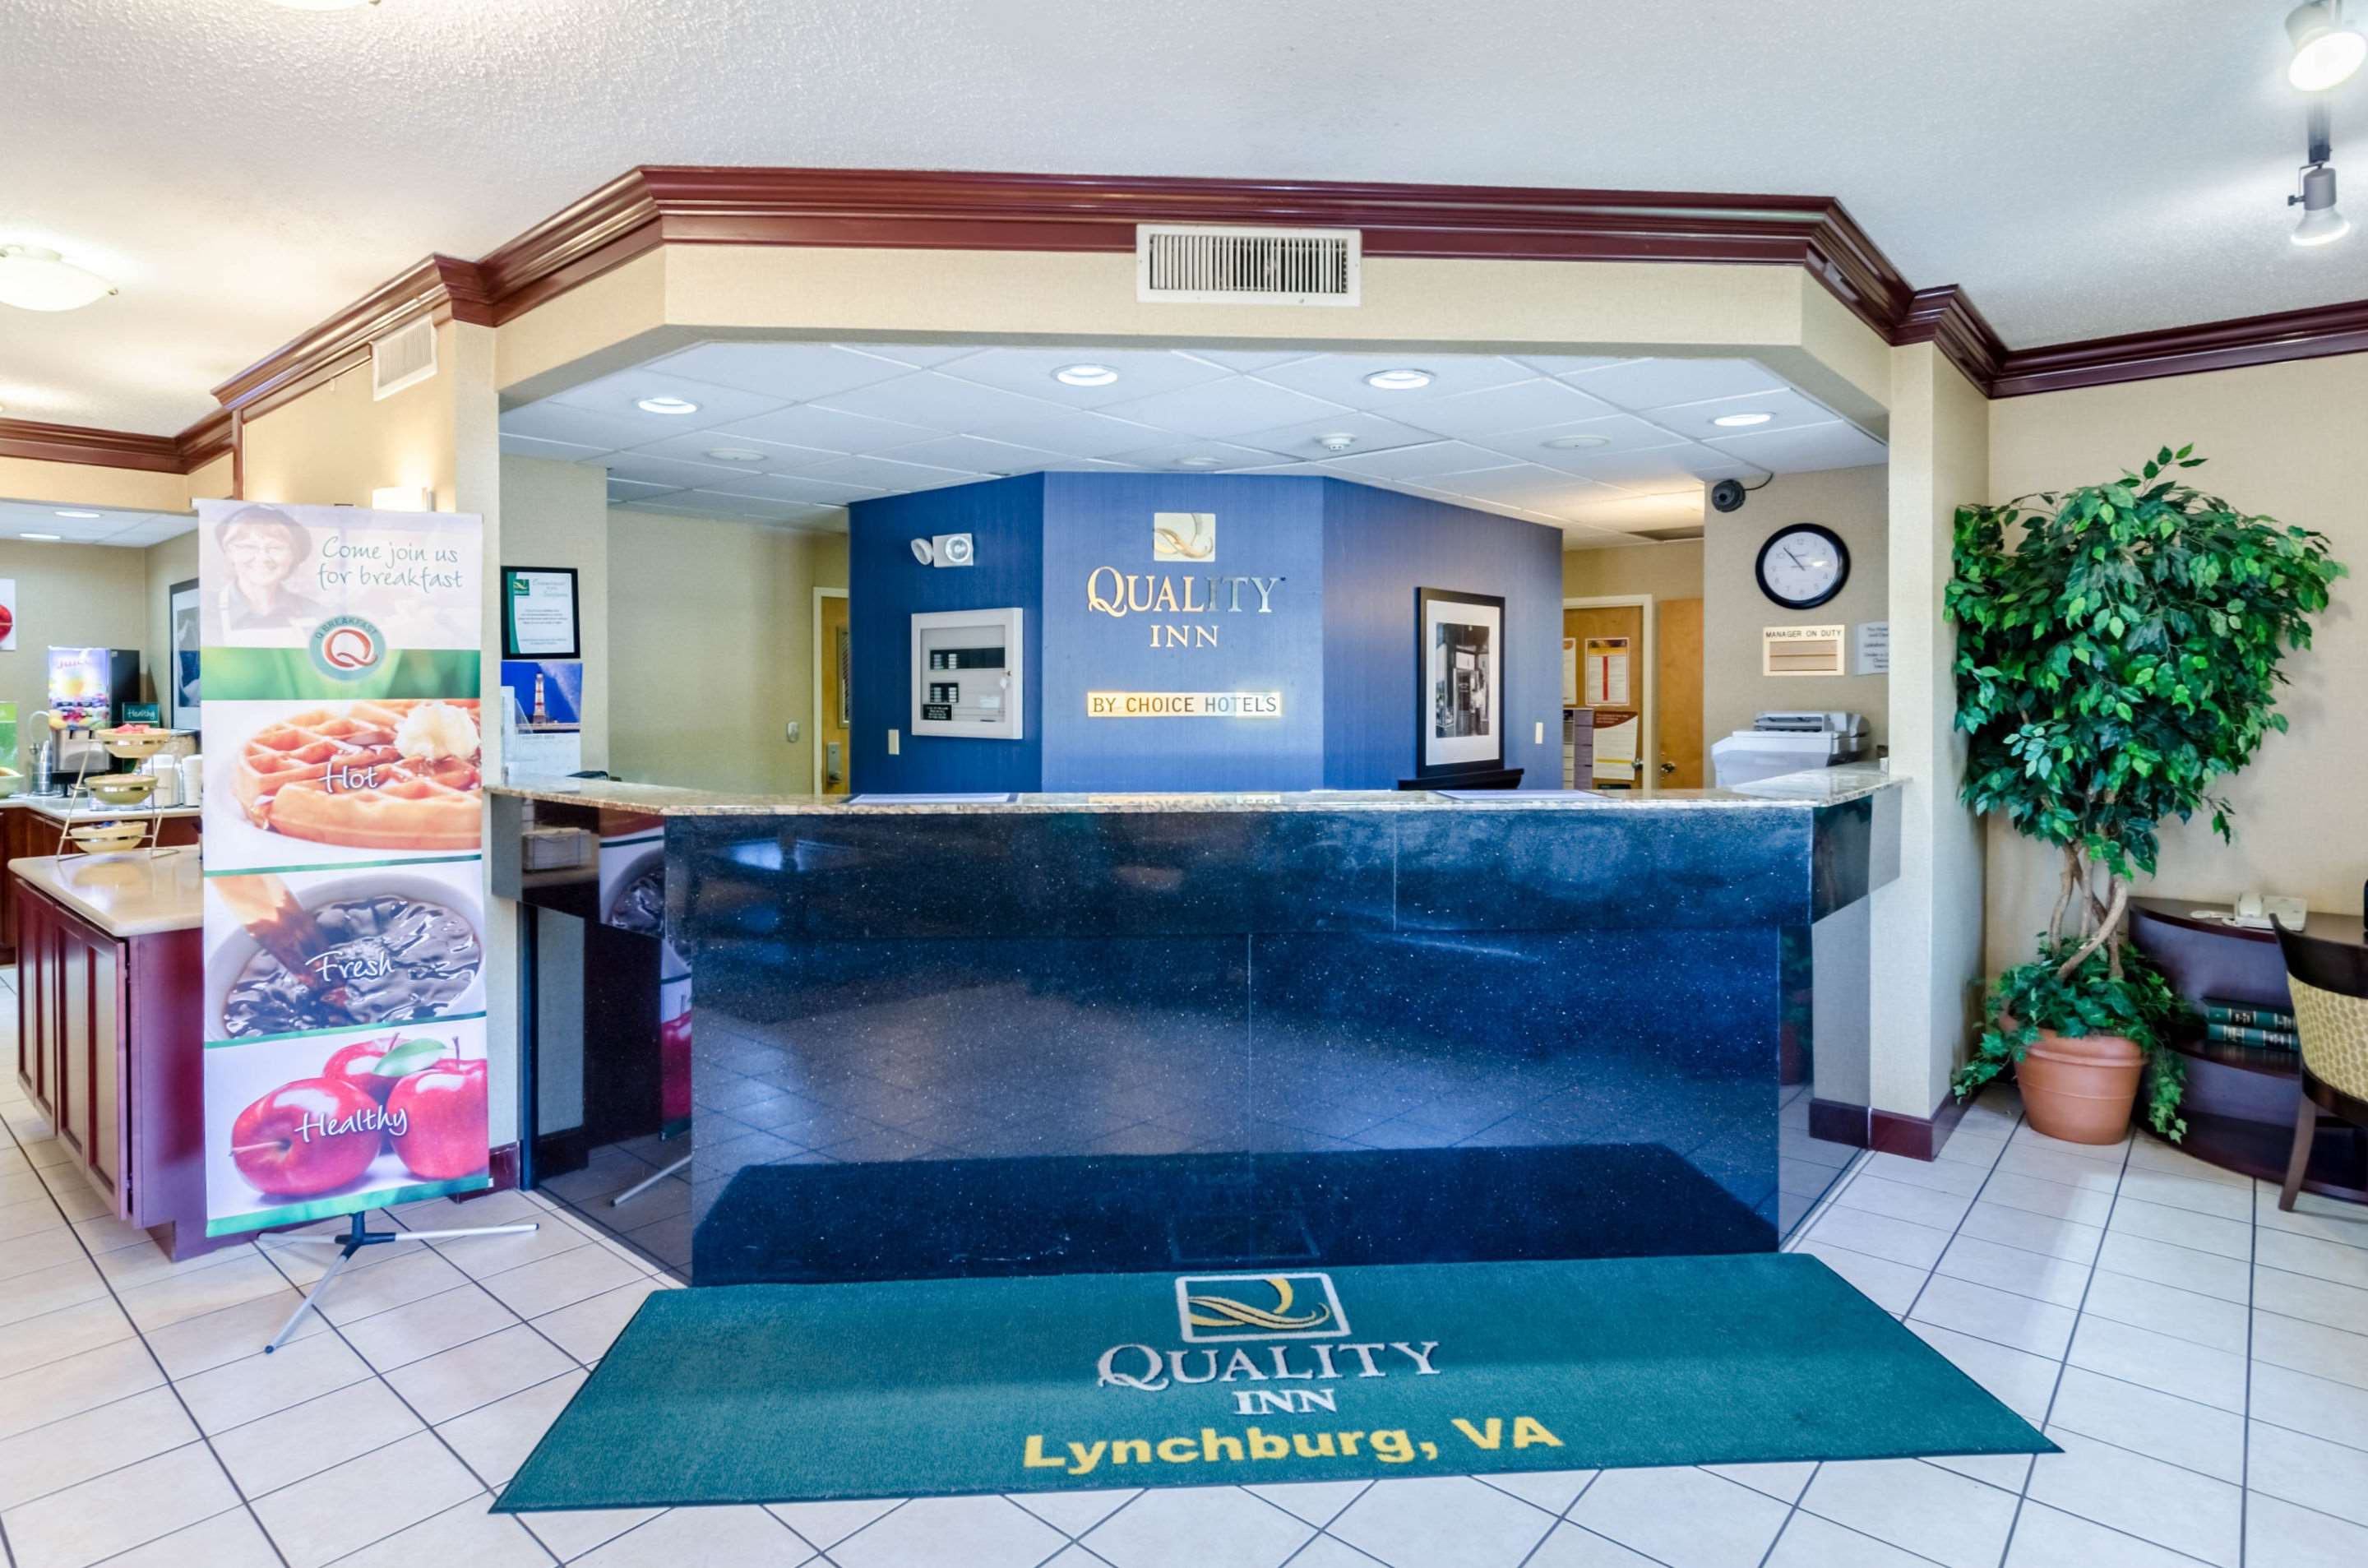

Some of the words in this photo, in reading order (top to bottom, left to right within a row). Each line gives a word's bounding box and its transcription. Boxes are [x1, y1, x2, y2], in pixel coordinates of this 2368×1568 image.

[322, 535, 382, 559] Come
[386, 542, 427, 569] join
[435, 552, 458, 562] us
[317, 562, 353, 591] for
[360, 566, 464, 594] breakfast
[1087, 566, 1279, 617] QUALITY
[321, 617, 378, 636] BREAKFAST
[1149, 625, 1219, 648] INN
[1765, 630, 1801, 638] MANAGER
[1806, 629, 1817, 637] ON
[1820, 629, 1842, 637] DUTY
[1093, 697, 1117, 713] BY
[1126, 696, 1195, 713] CHOICE
[1205, 696, 1277, 712] HOTELS
[317, 762, 378, 793] Hot
[305, 951, 395, 983] Fresh
[294, 1104, 408, 1143] Healthy
[1096, 1341, 1442, 1391] QUALITY
[1233, 1388, 1337, 1416] INN
[1023, 1426, 1439, 1475] Lynchburg,
[1451, 1416, 1564, 1450] VA
